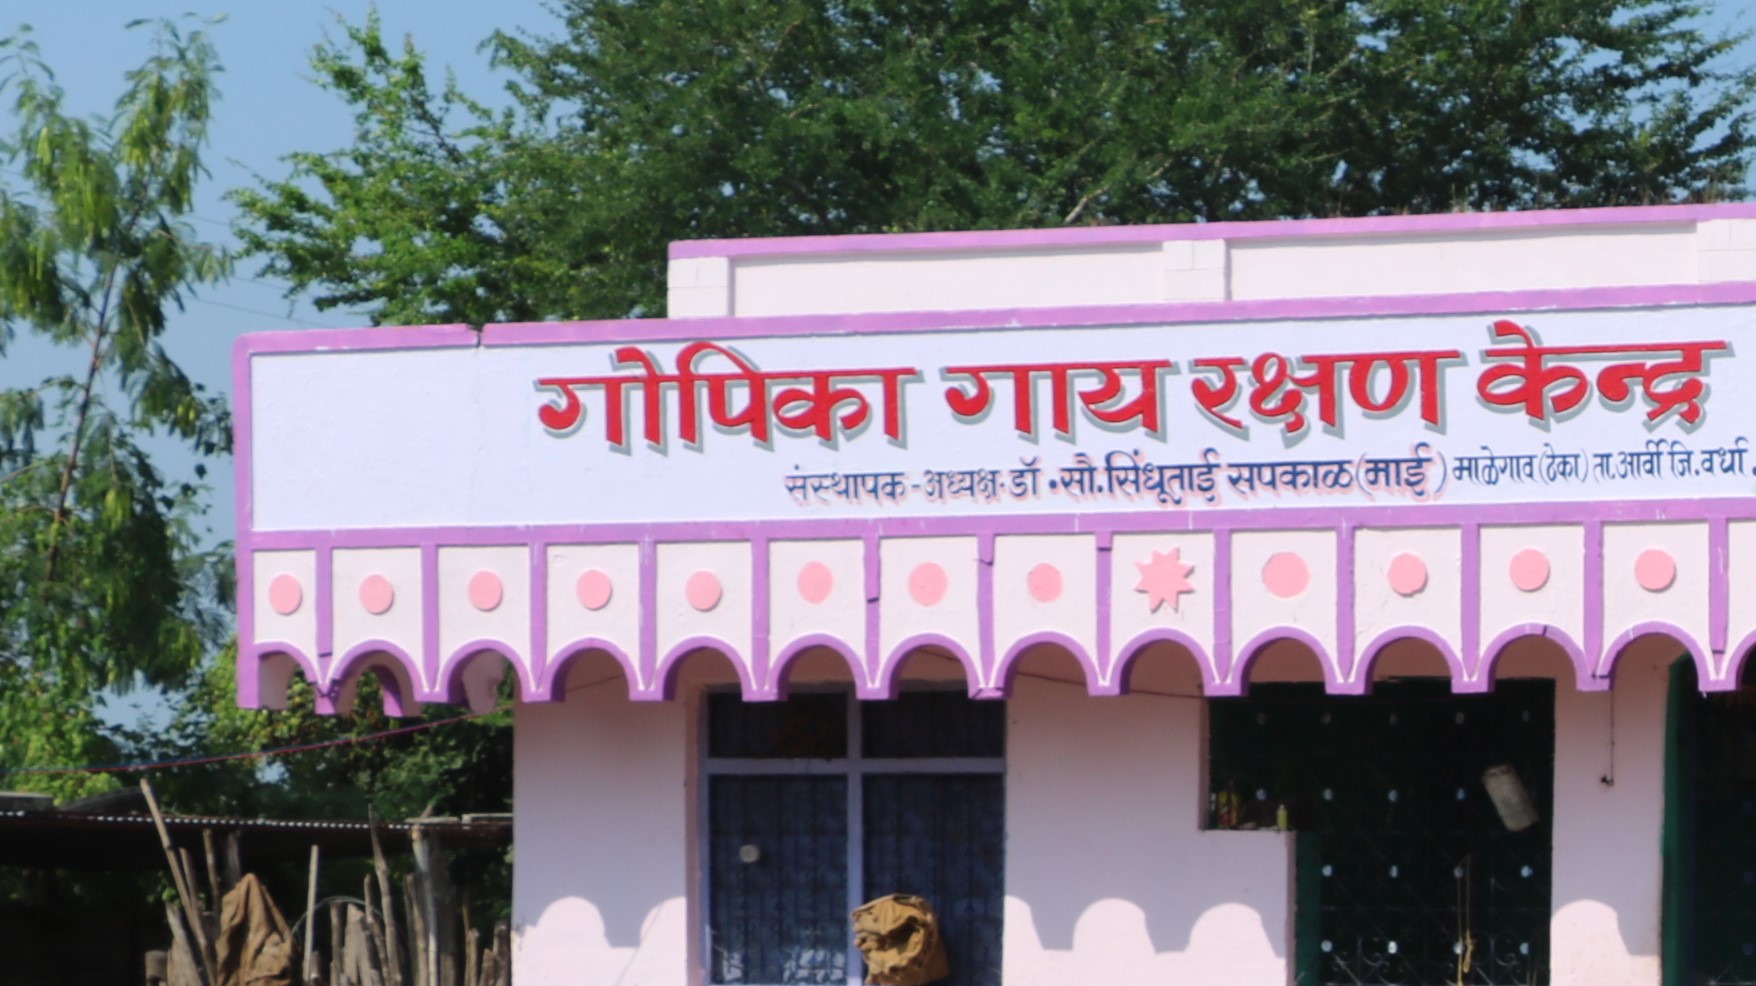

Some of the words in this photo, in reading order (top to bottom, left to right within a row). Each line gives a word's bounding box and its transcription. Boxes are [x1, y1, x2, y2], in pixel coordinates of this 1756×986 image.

[538, 341, 923, 456] गोपिका
[944, 358, 1176, 444] गाय
[1190, 348, 1466, 447] रक्षण
[1475, 320, 1734, 437] केन्द्र
